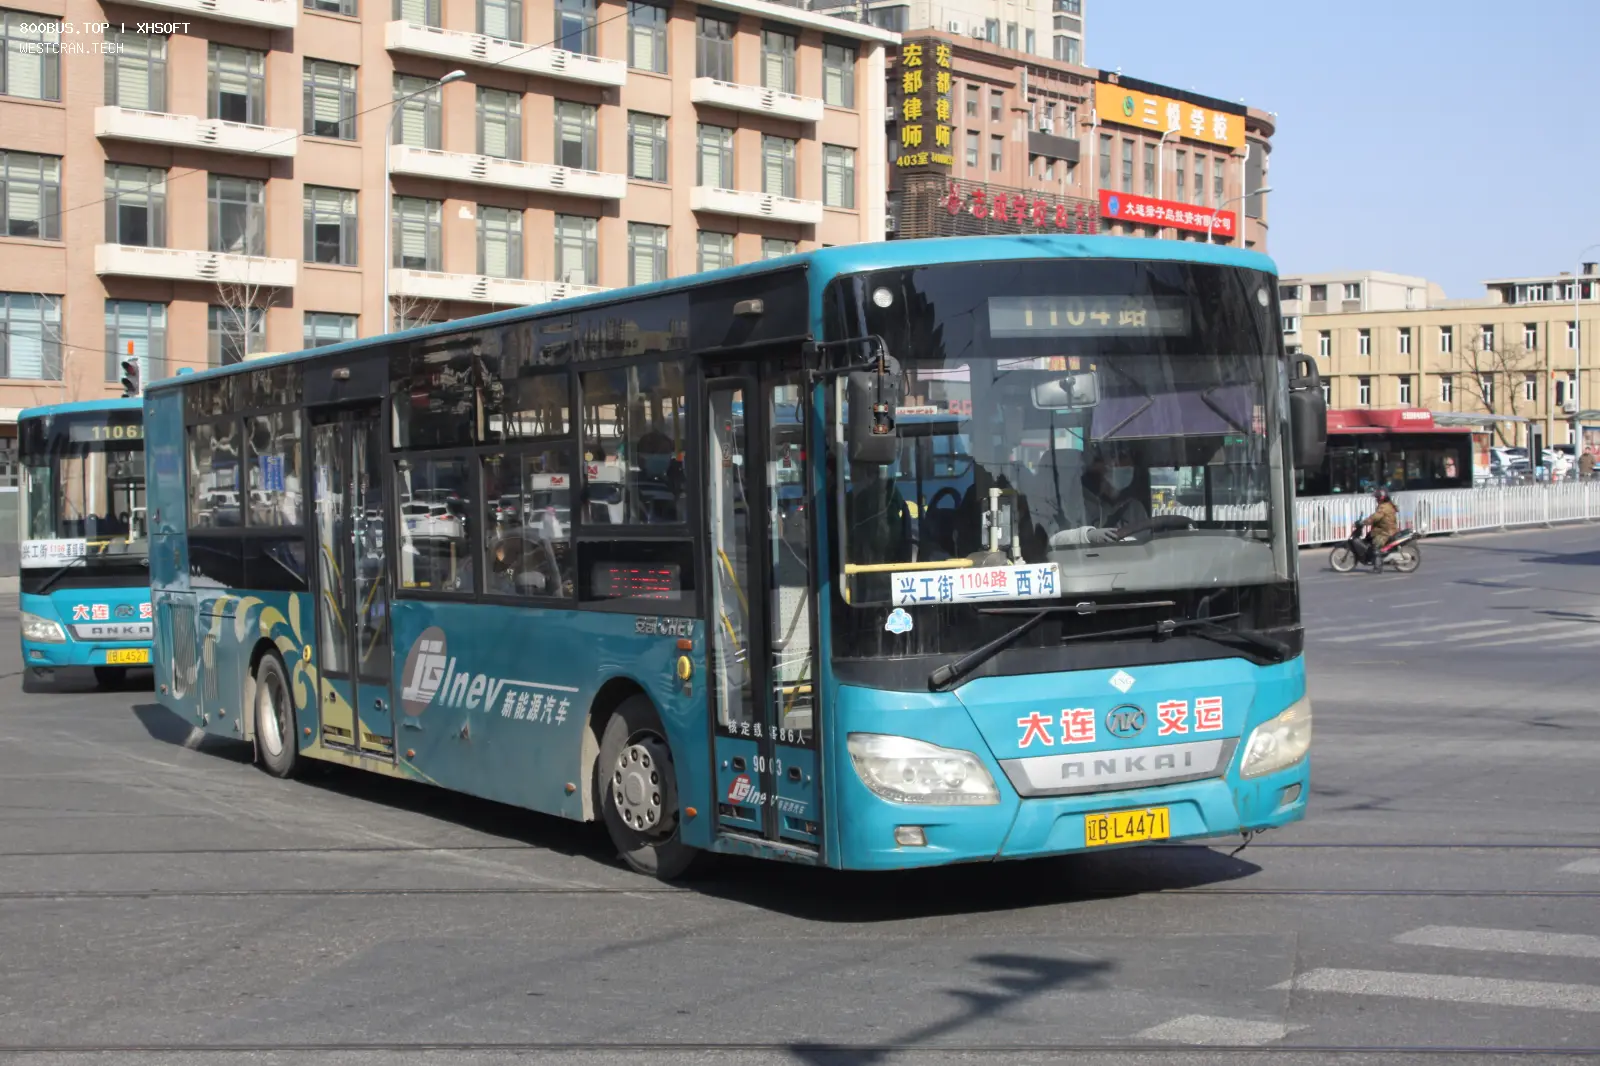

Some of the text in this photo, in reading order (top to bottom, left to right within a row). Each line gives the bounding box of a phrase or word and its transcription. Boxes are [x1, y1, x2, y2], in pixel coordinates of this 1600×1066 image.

[902, 43, 923, 148] 宏都律师
[935, 44, 951, 148] 宏都律师
[91, 425, 145, 440] 1106
[899, 568, 1055, 604] 兴工街 1104路 西沟
[72, 604, 109, 620] 大连
[501, 689, 571, 727] 新能源汽车
[1017, 707, 1096, 748] 大连
[1157, 696, 1224, 736] 交运
[1061, 751, 1194, 780] ANKAI
